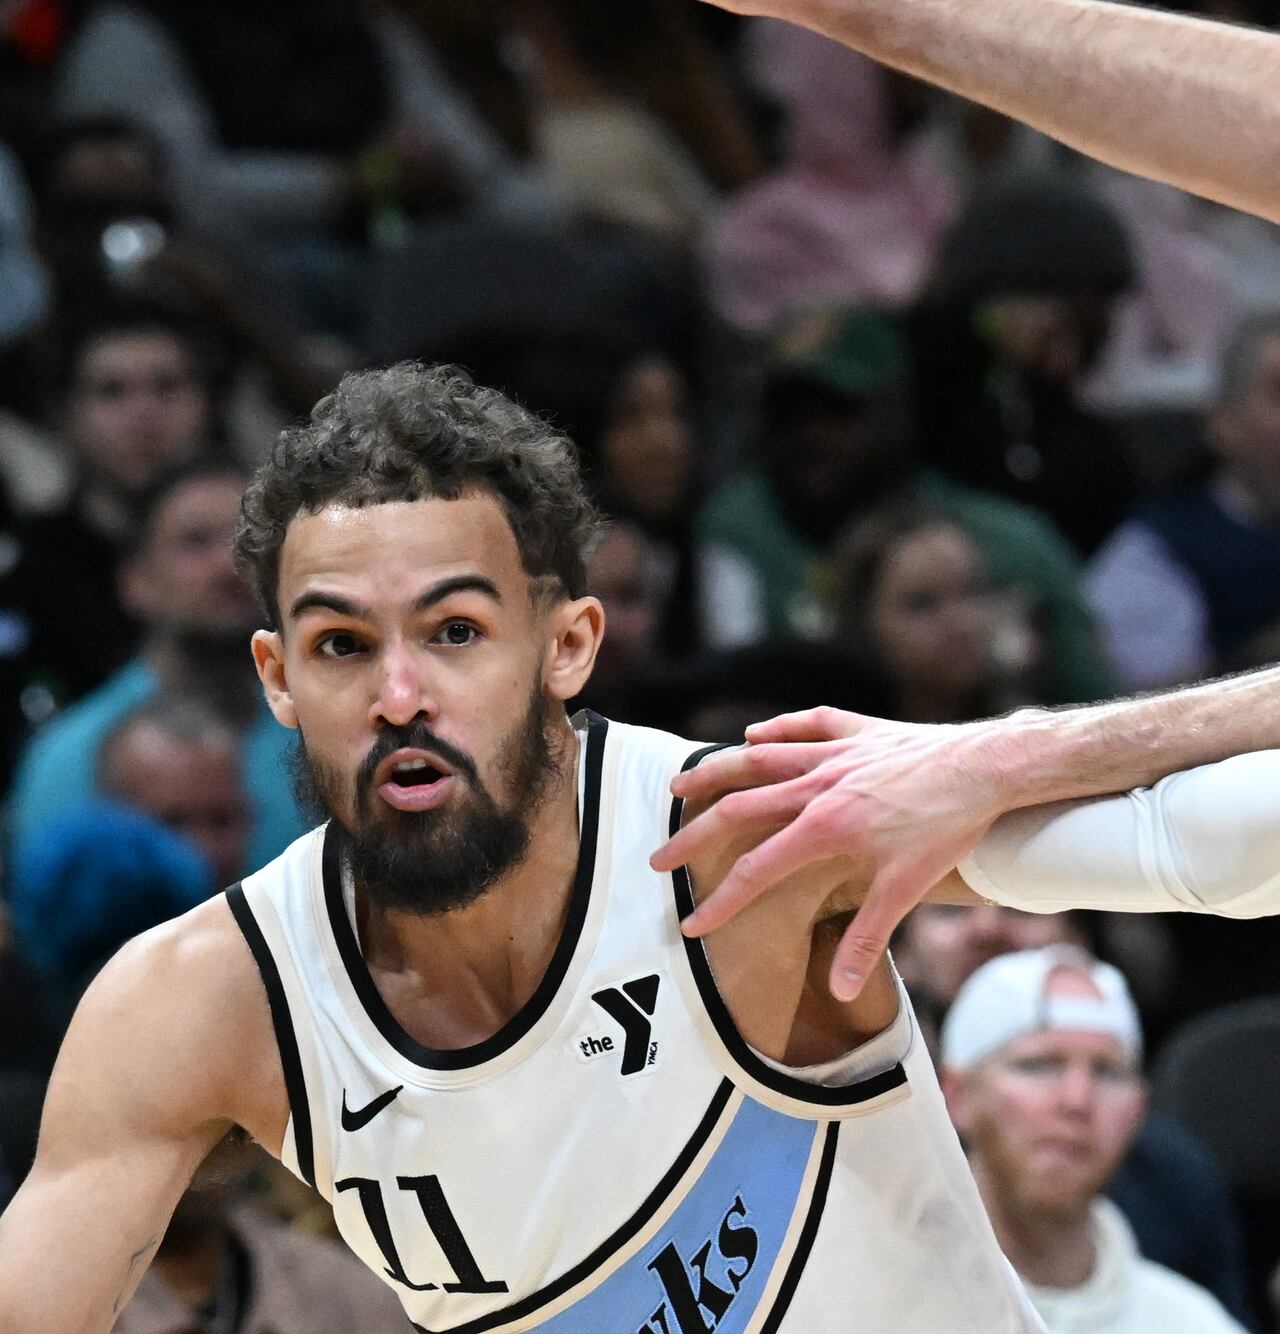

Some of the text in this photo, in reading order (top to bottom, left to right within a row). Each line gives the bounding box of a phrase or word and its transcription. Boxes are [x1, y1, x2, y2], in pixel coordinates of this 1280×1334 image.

[580, 974, 660, 1076] the Y
[647, 1042, 659, 1066] YMCA
[334, 1174, 510, 1294] 11
